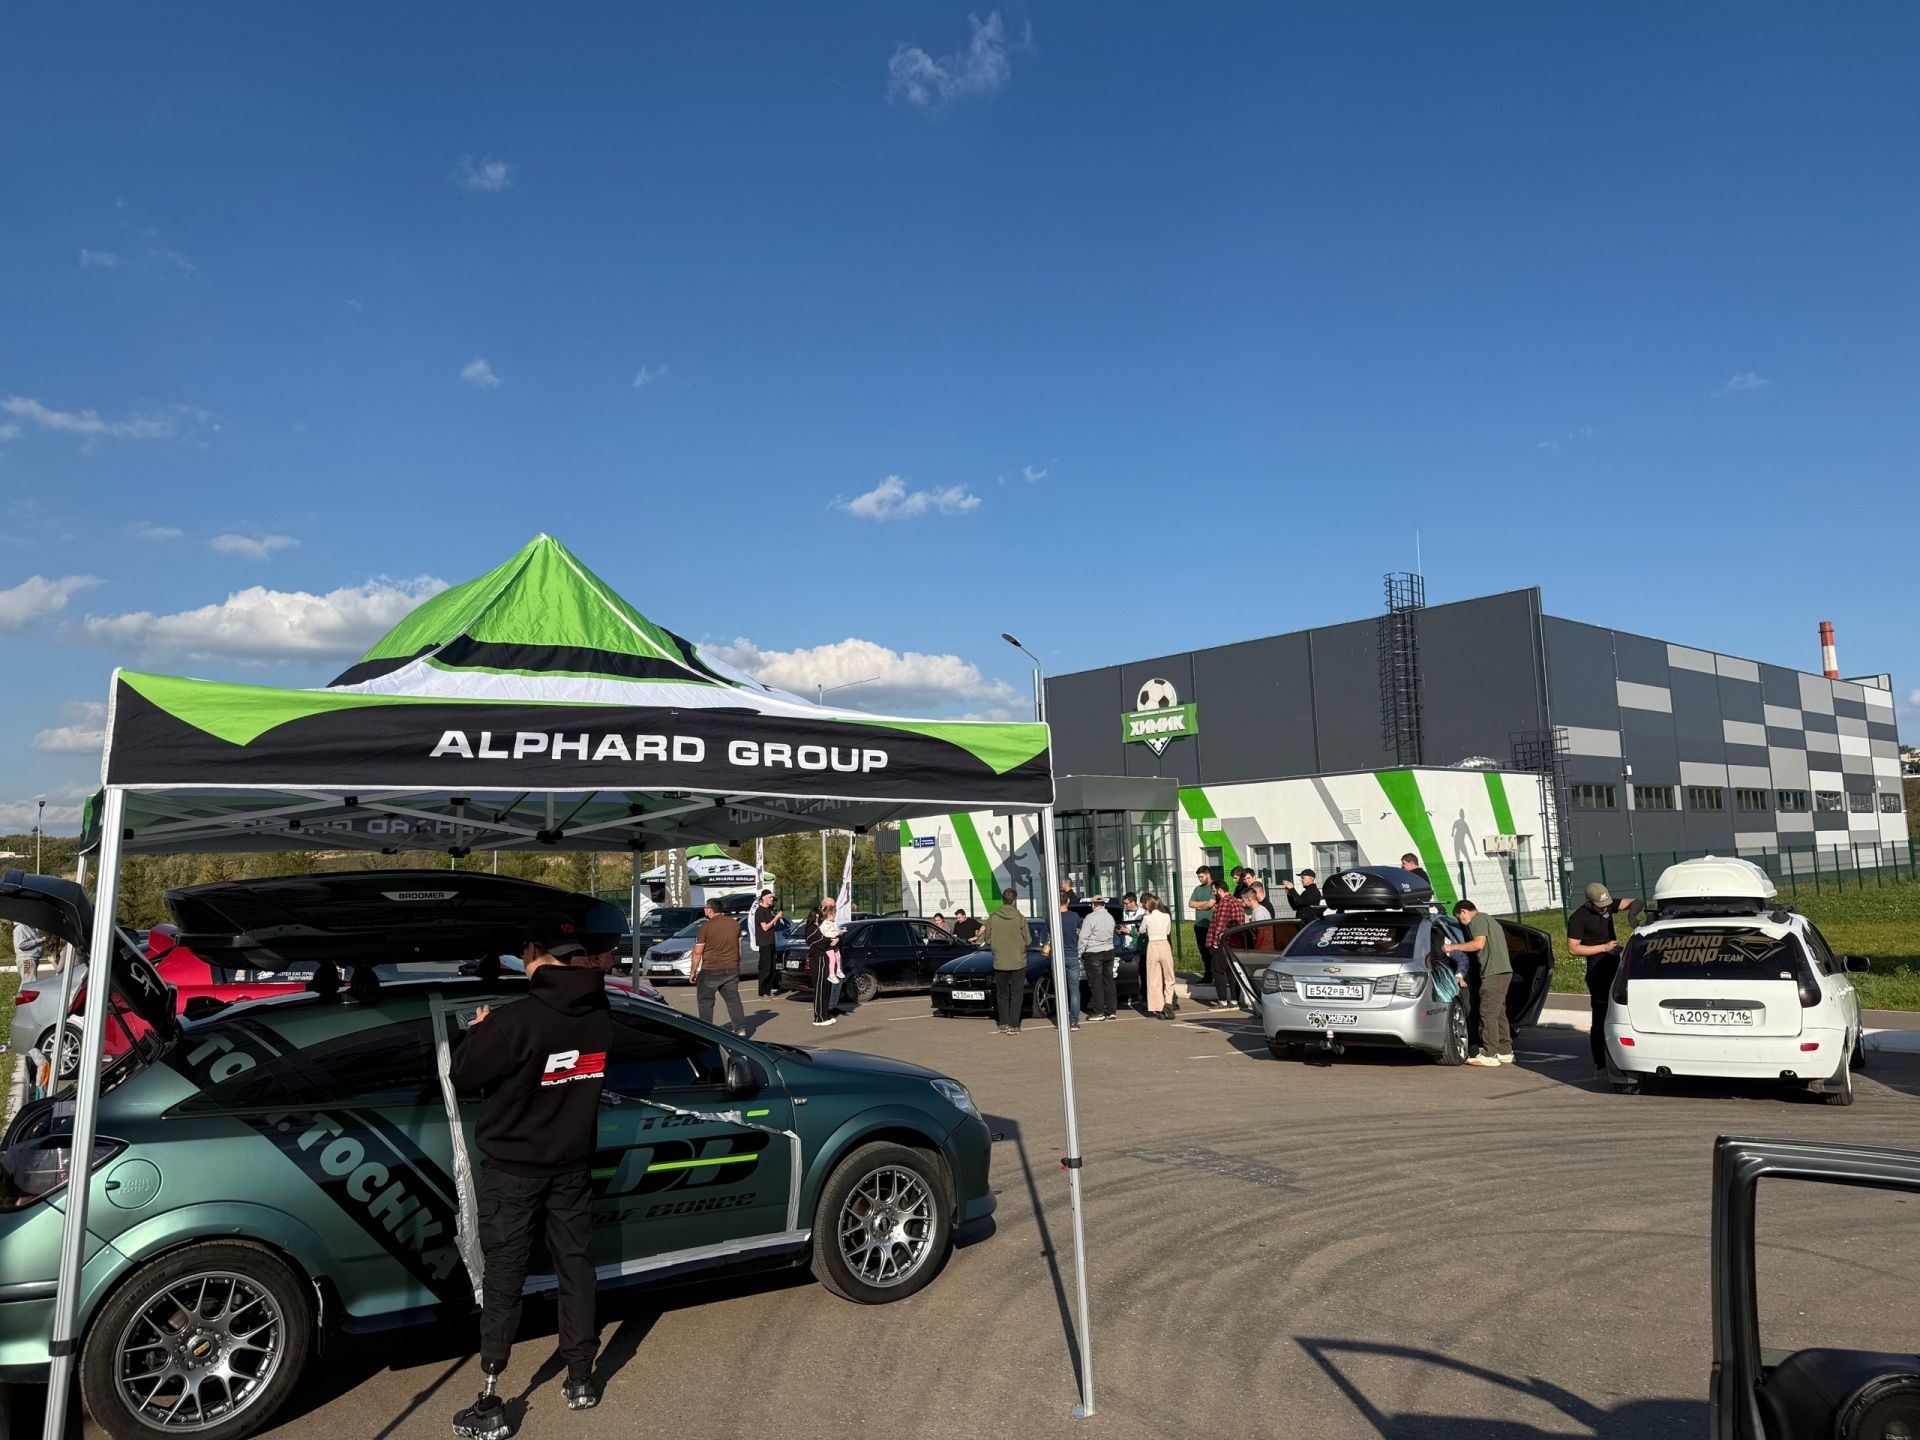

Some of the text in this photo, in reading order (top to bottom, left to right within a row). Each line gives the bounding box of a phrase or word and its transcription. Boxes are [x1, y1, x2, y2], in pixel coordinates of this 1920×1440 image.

[1129, 714, 1186, 737] ХИМИК
[429, 730, 889, 773] ALPHARD GROUP
[398, 892, 445, 900] BROOMER
[1643, 935, 1724, 957] DIAMOND
[1661, 947, 1745, 965] SOUND TEAM
[541, 1049, 607, 1081] RS
[541, 1072, 605, 1086] CUSTOMS
[296, 1111, 461, 1280] TOCHKA
